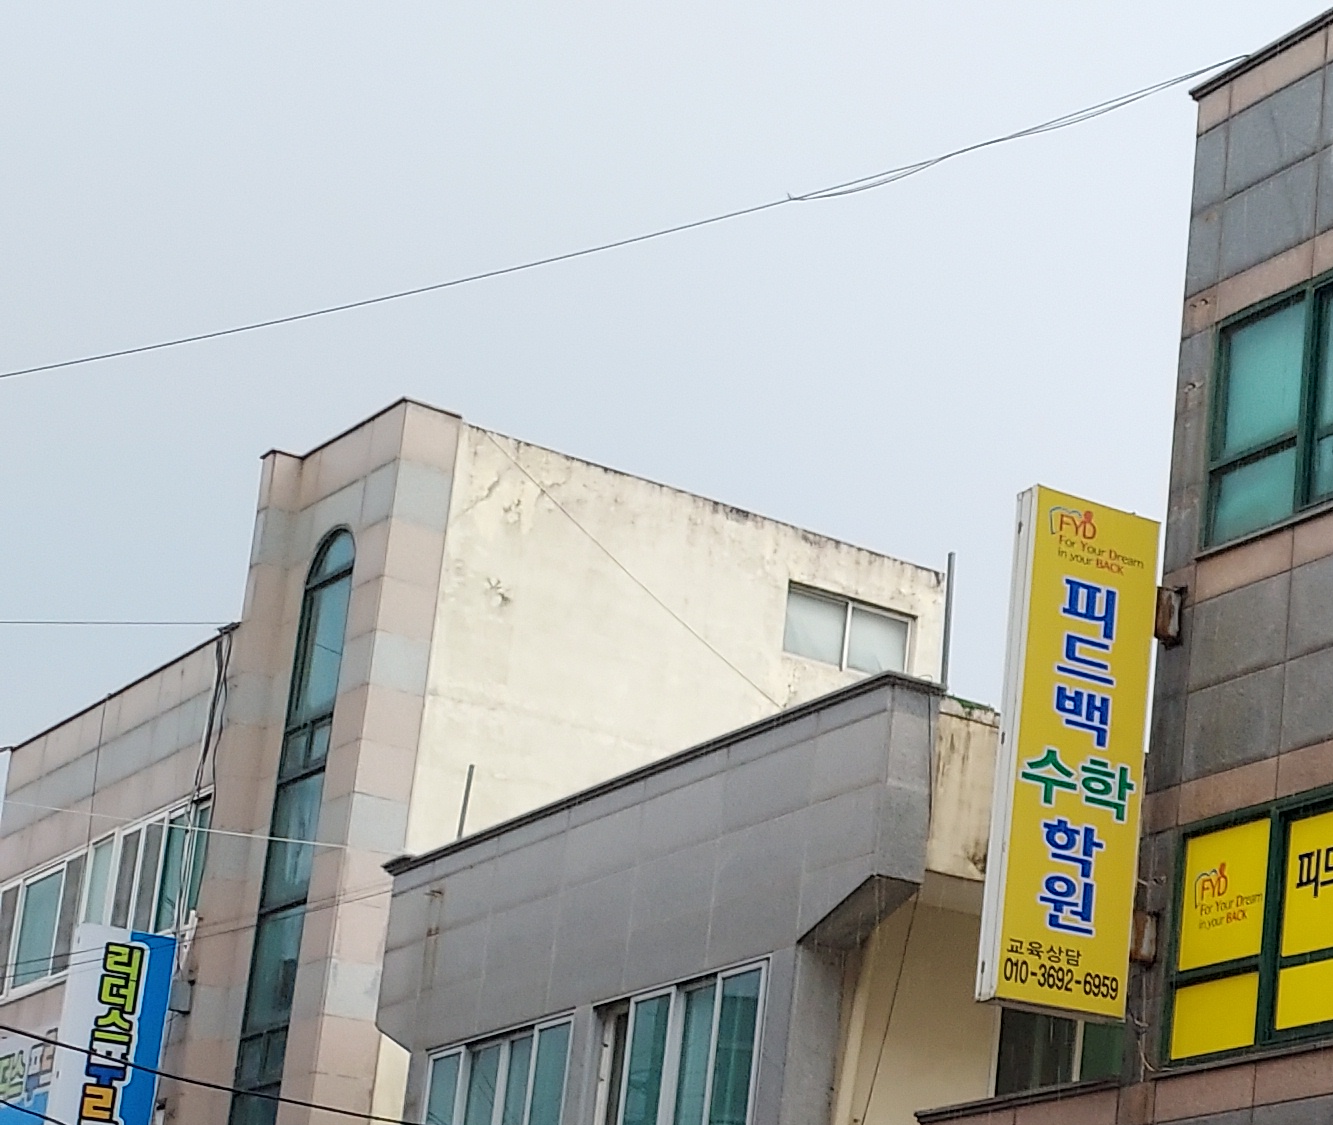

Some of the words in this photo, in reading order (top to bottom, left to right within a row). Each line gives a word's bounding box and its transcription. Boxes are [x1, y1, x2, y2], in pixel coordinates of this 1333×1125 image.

[1060, 513, 1096, 539] FYD
[1058, 549, 1067, 557] in
[1070, 553, 1093, 565] your
[1096, 559, 1124, 575] BACK
[1059, 535, 1075, 547] For
[1081, 541, 1106, 557] Your
[1109, 549, 1144, 569] Dream
[1054, 577, 1118, 750] 피드백
[1020, 749, 1135, 823] 수학
[1039, 818, 1103, 938] 학원
[1201, 876, 1228, 901] FYD
[1006, 938, 1082, 966] 교육상담
[94, 942, 145, 1041] 리더스
[1003, 957, 1119, 1001] 010-3692-6959
